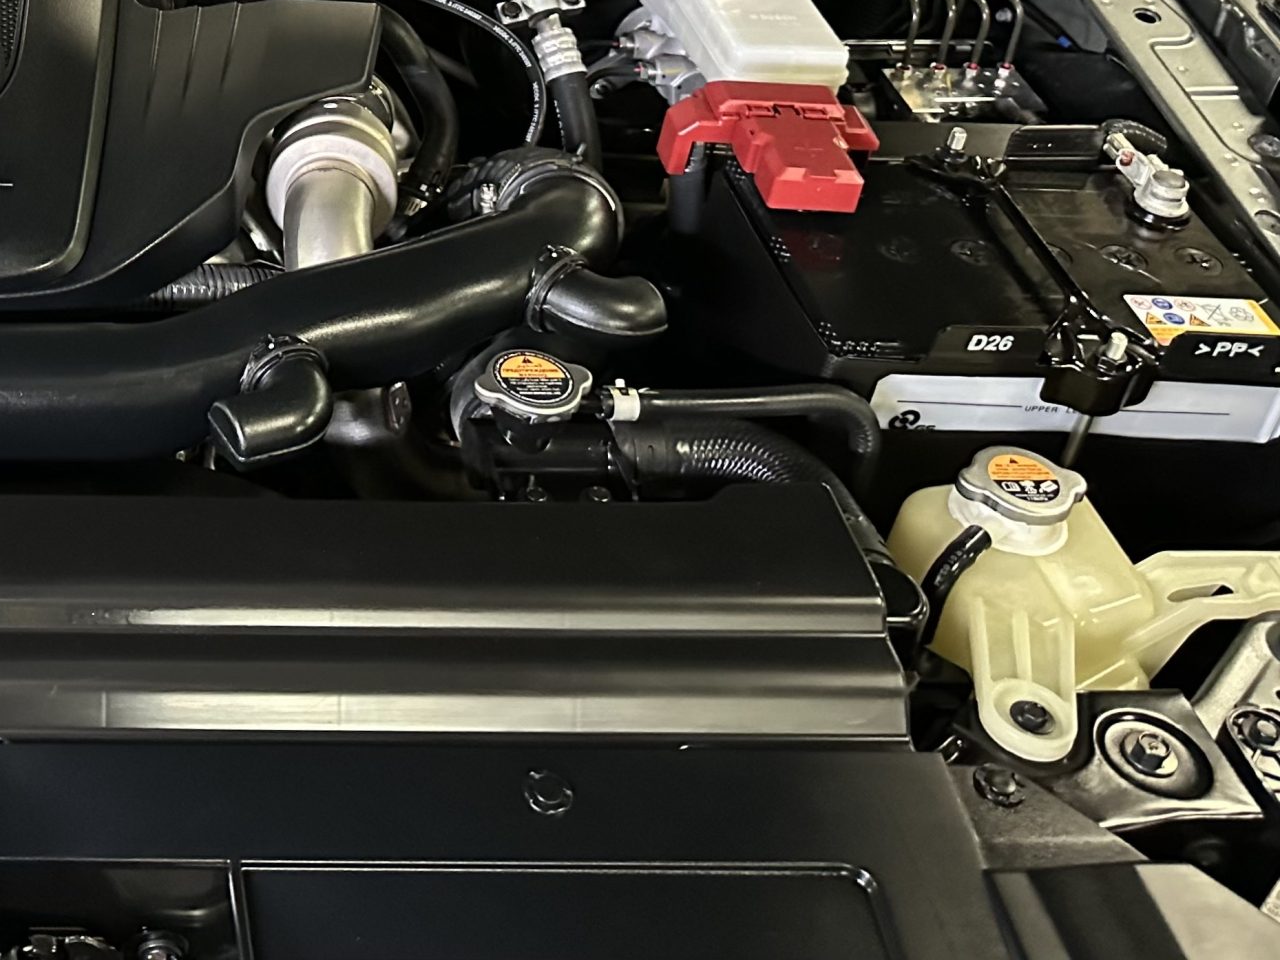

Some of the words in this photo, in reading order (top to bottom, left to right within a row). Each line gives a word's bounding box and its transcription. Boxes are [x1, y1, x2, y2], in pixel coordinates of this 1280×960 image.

[967, 334, 1015, 351] D26
[1194, 341, 1265, 357] >PP<
[1024, 405, 1058, 413] UPPER
